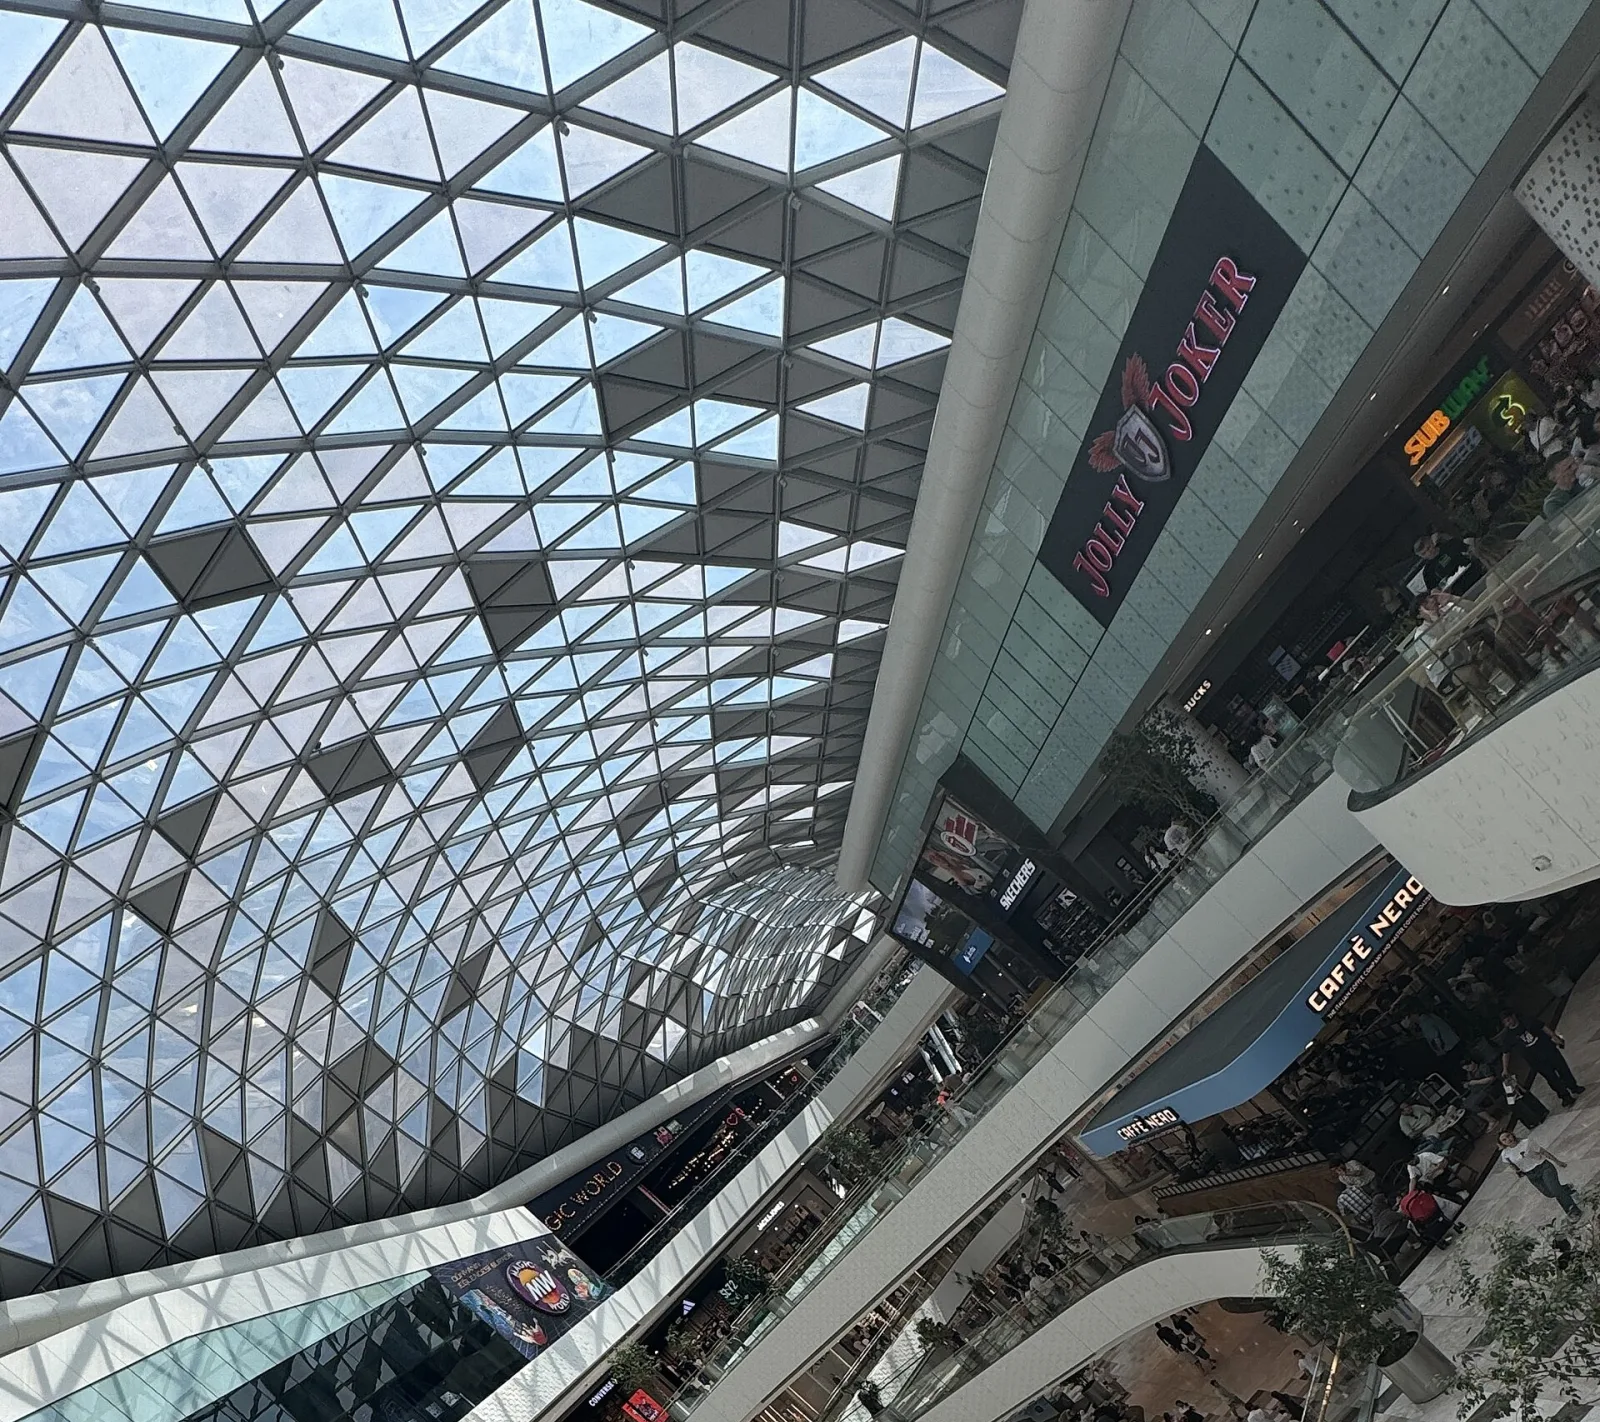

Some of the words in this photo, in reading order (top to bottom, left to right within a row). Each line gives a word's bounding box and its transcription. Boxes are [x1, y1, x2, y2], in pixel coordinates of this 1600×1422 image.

[1072, 474, 1145, 598] JOLLY
[1149, 256, 1257, 441] JOKER
[1404, 355, 1490, 466] SUBWAY
[999, 857, 1036, 911] SKECHERS
[1308, 935, 1372, 1012] CAFFÈ
[1369, 876, 1424, 938] NERO
[1335, 992, 1351, 1010] ITALIAN
[1349, 975, 1365, 994] COFFEE
[1363, 953, 1383, 976] COMPANY
[1382, 944, 1392, 955] AND
[1390, 926, 1405, 945] MASTER
[1403, 910, 1419, 929] COFFEE
[1116, 1118, 1150, 1140] CAFFÈ
[1145, 1109, 1177, 1129] NERO
[572, 1161, 623, 1206] WORLD
[511, 1260, 538, 1278] MAGIC
[525, 1270, 558, 1301] MW
[550, 1292, 569, 1312] WORLD
[588, 1379, 614, 1407] CONVERSE
